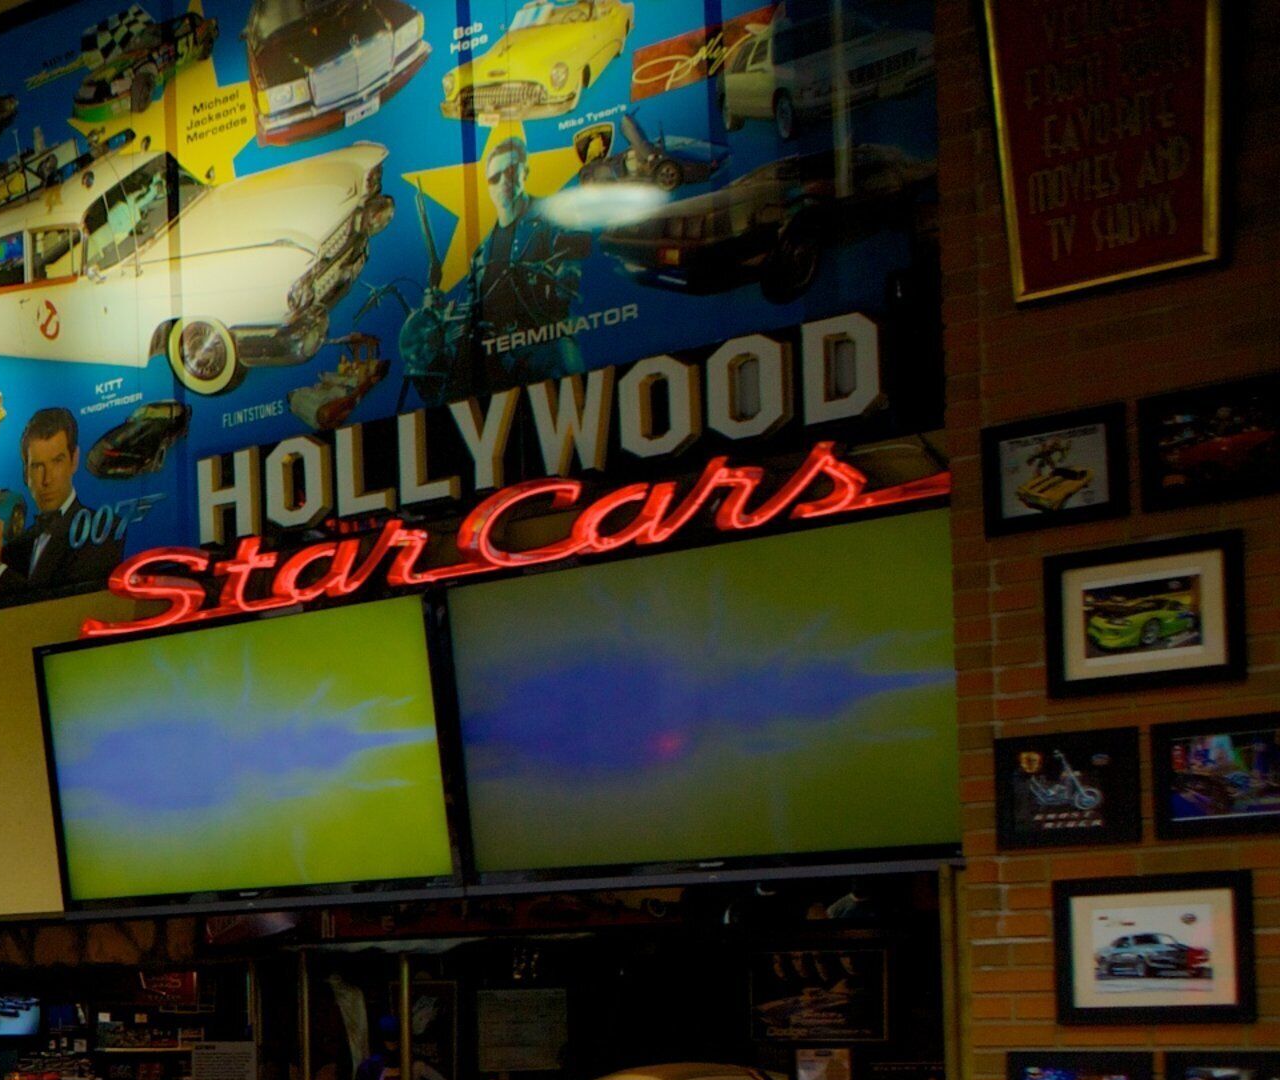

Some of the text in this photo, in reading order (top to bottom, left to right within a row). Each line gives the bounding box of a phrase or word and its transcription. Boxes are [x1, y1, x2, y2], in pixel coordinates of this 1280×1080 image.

[450, 33, 489, 54] Hope
[453, 21, 484, 40] Bob
[193, 89, 239, 115] Michael
[186, 102, 247, 131] Jackson's
[186, 116, 248, 144] Mercedes
[558, 103, 627, 130] Mike Tyson's
[1027, 152, 1121, 215] MOVIES
[1045, 191, 1178, 261] TV SHOWS
[481, 303, 639, 356] TERMINATOR
[95, 377, 124, 394] KITT
[80, 391, 144, 416] KNIGHTRIDER
[222, 400, 284, 428] FLINTSTONES
[196, 311, 890, 546] HOLLYWOOD
[69, 495, 145, 548] 007
[77, 440, 952, 640] Star Cars
